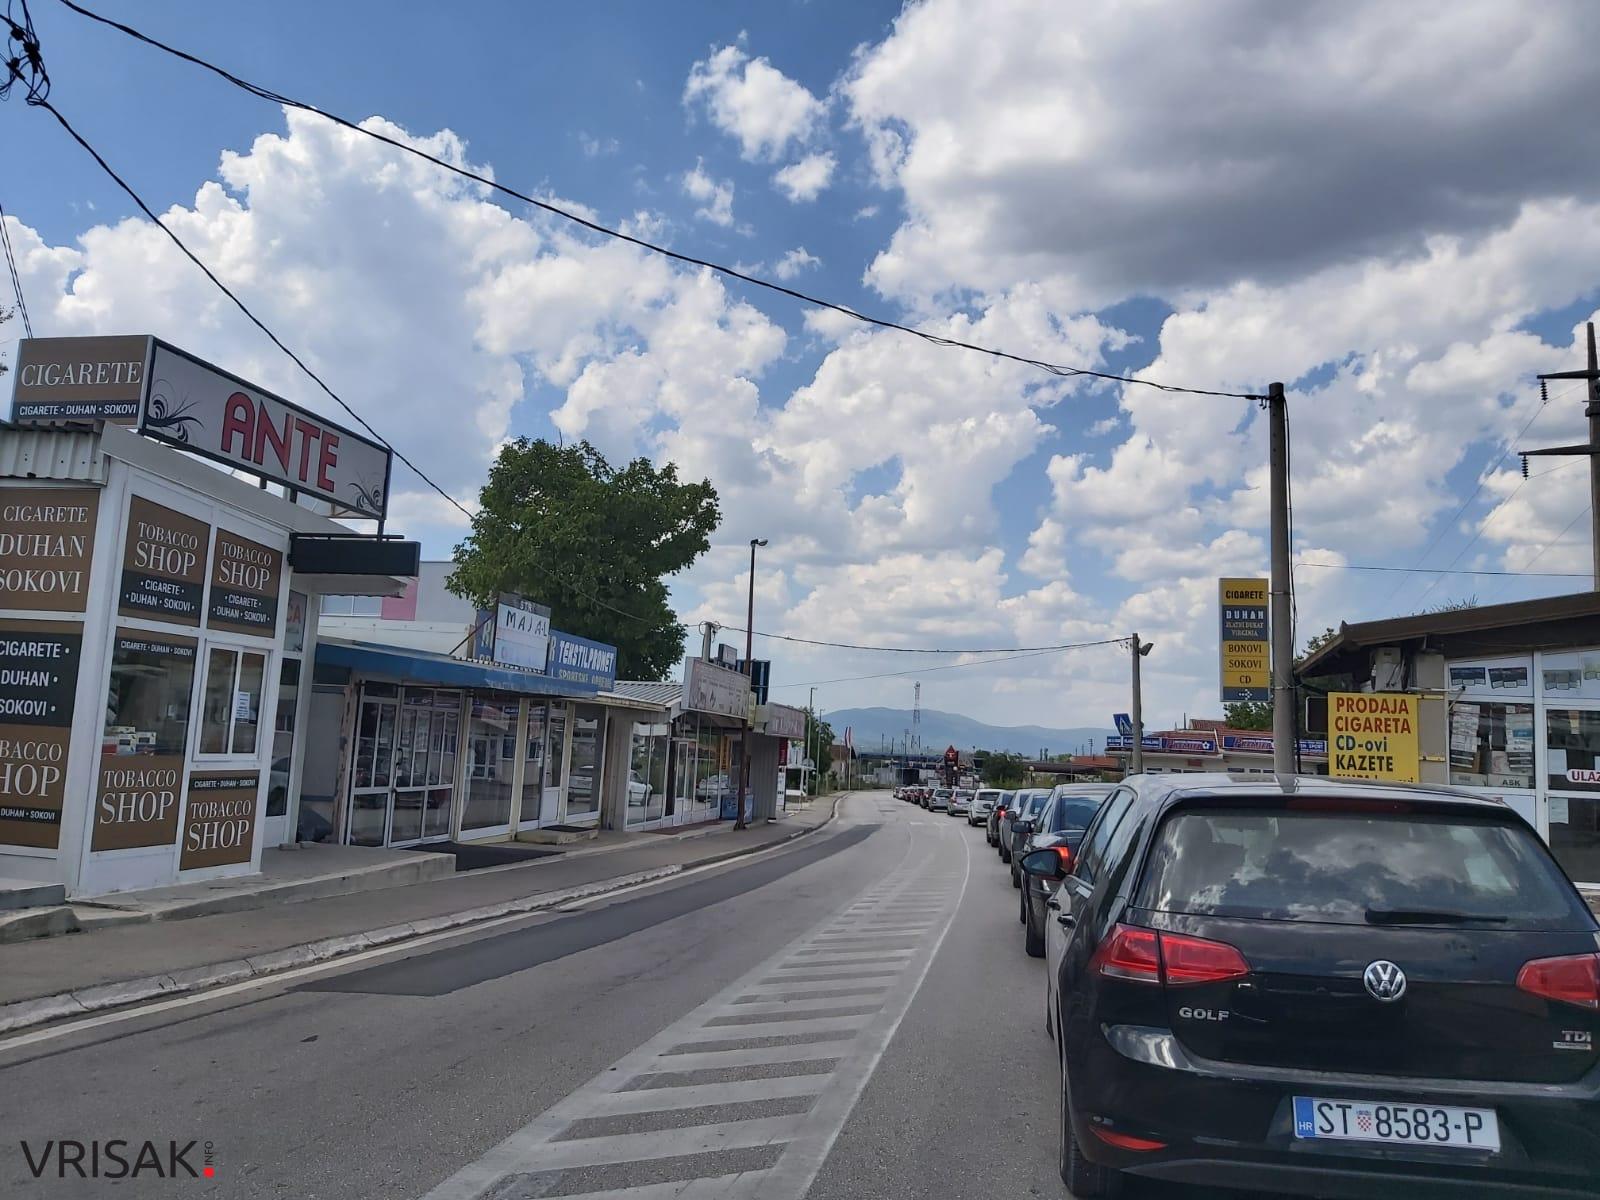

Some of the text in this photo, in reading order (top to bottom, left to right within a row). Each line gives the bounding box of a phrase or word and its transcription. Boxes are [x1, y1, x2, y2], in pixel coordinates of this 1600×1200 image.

[20, 361, 142, 387] CIGARETE
[19, 403, 137, 416] CIGARETE DUHAN SOKOVI
[220, 391, 340, 493] ANTE
[3, 505, 88, 523] CIGARETE
[138, 521, 198, 550] TOBACCO
[0, 533, 86, 558] DUHAN
[221, 541, 272, 567] TOBACCO
[134, 541, 196, 576] SHOP
[0, 568, 84, 594] SOKOVI
[218, 559, 270, 591] SHOP
[145, 579, 181, 595] CIGARETE
[1226, 590, 1263, 600] CIGARETE
[130, 593, 191, 612] DUHAN SOKOVI
[228, 593, 258, 608] CIGARETE
[216, 605, 266, 623] DUHAN SOKOVI
[1226, 610, 1264, 620] DUHAN
[0, 640, 62, 657] CIGARETE
[120, 640, 192, 656] CIGARETE DUHAN SOKOVI
[1228, 644, 1262, 653] BONOVI
[1228, 659, 1262, 669] SOKOVI
[1, 669, 50, 686] DUHAN
[1240, 675, 1251, 684] CD
[0, 698, 47, 716] SOKOVI
[1336, 697, 1409, 714] PRODAJA
[1335, 716, 1411, 734] CIGARETA
[1336, 735, 1387, 752] CD-ovi
[1336, 754, 1393, 772] KAZETE
[103, 769, 176, 789] TOBACCO
[194, 779, 217, 788] CIGARETE
[220, 779, 237, 788] DUHAN
[1, 808, 55, 820] DUHAN SOKOVI
[100, 791, 174, 825] SHOP
[191, 799, 251, 819] TOBACCO
[186, 819, 249, 852] SHOP
[1178, 1007, 1230, 1022] GOLF
[1298, 1120, 1314, 1132] HR
[1316, 1101, 1483, 1144] ST 8583-P
